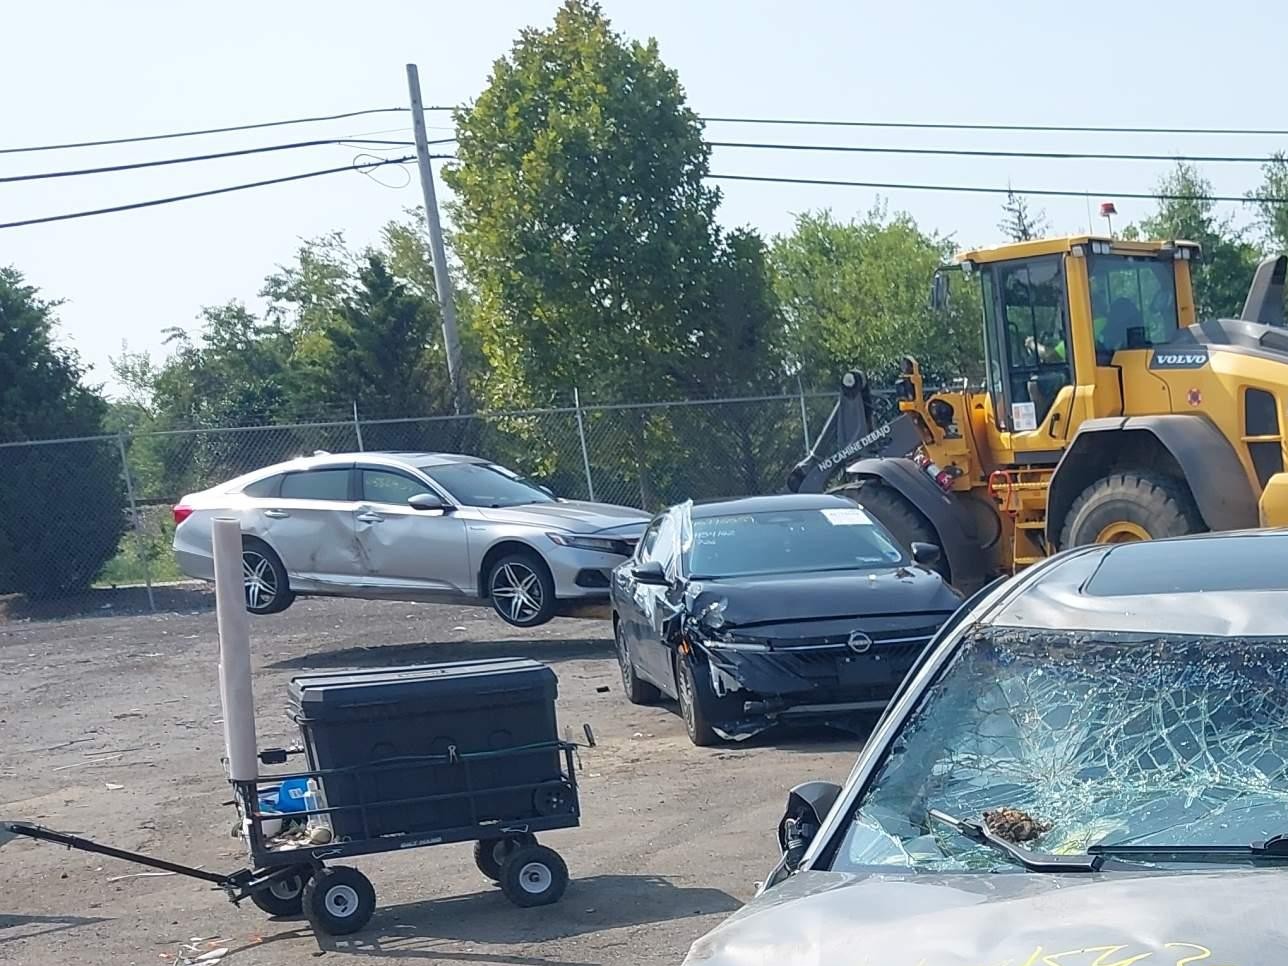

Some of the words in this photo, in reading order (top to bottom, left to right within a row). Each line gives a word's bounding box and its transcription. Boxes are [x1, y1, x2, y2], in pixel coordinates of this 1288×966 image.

[1156, 354, 1207, 365] VOLVO
[818, 461, 832, 472] NO
[833, 442, 862, 463] CAMINE
[861, 424, 891, 447] DEBAJO
